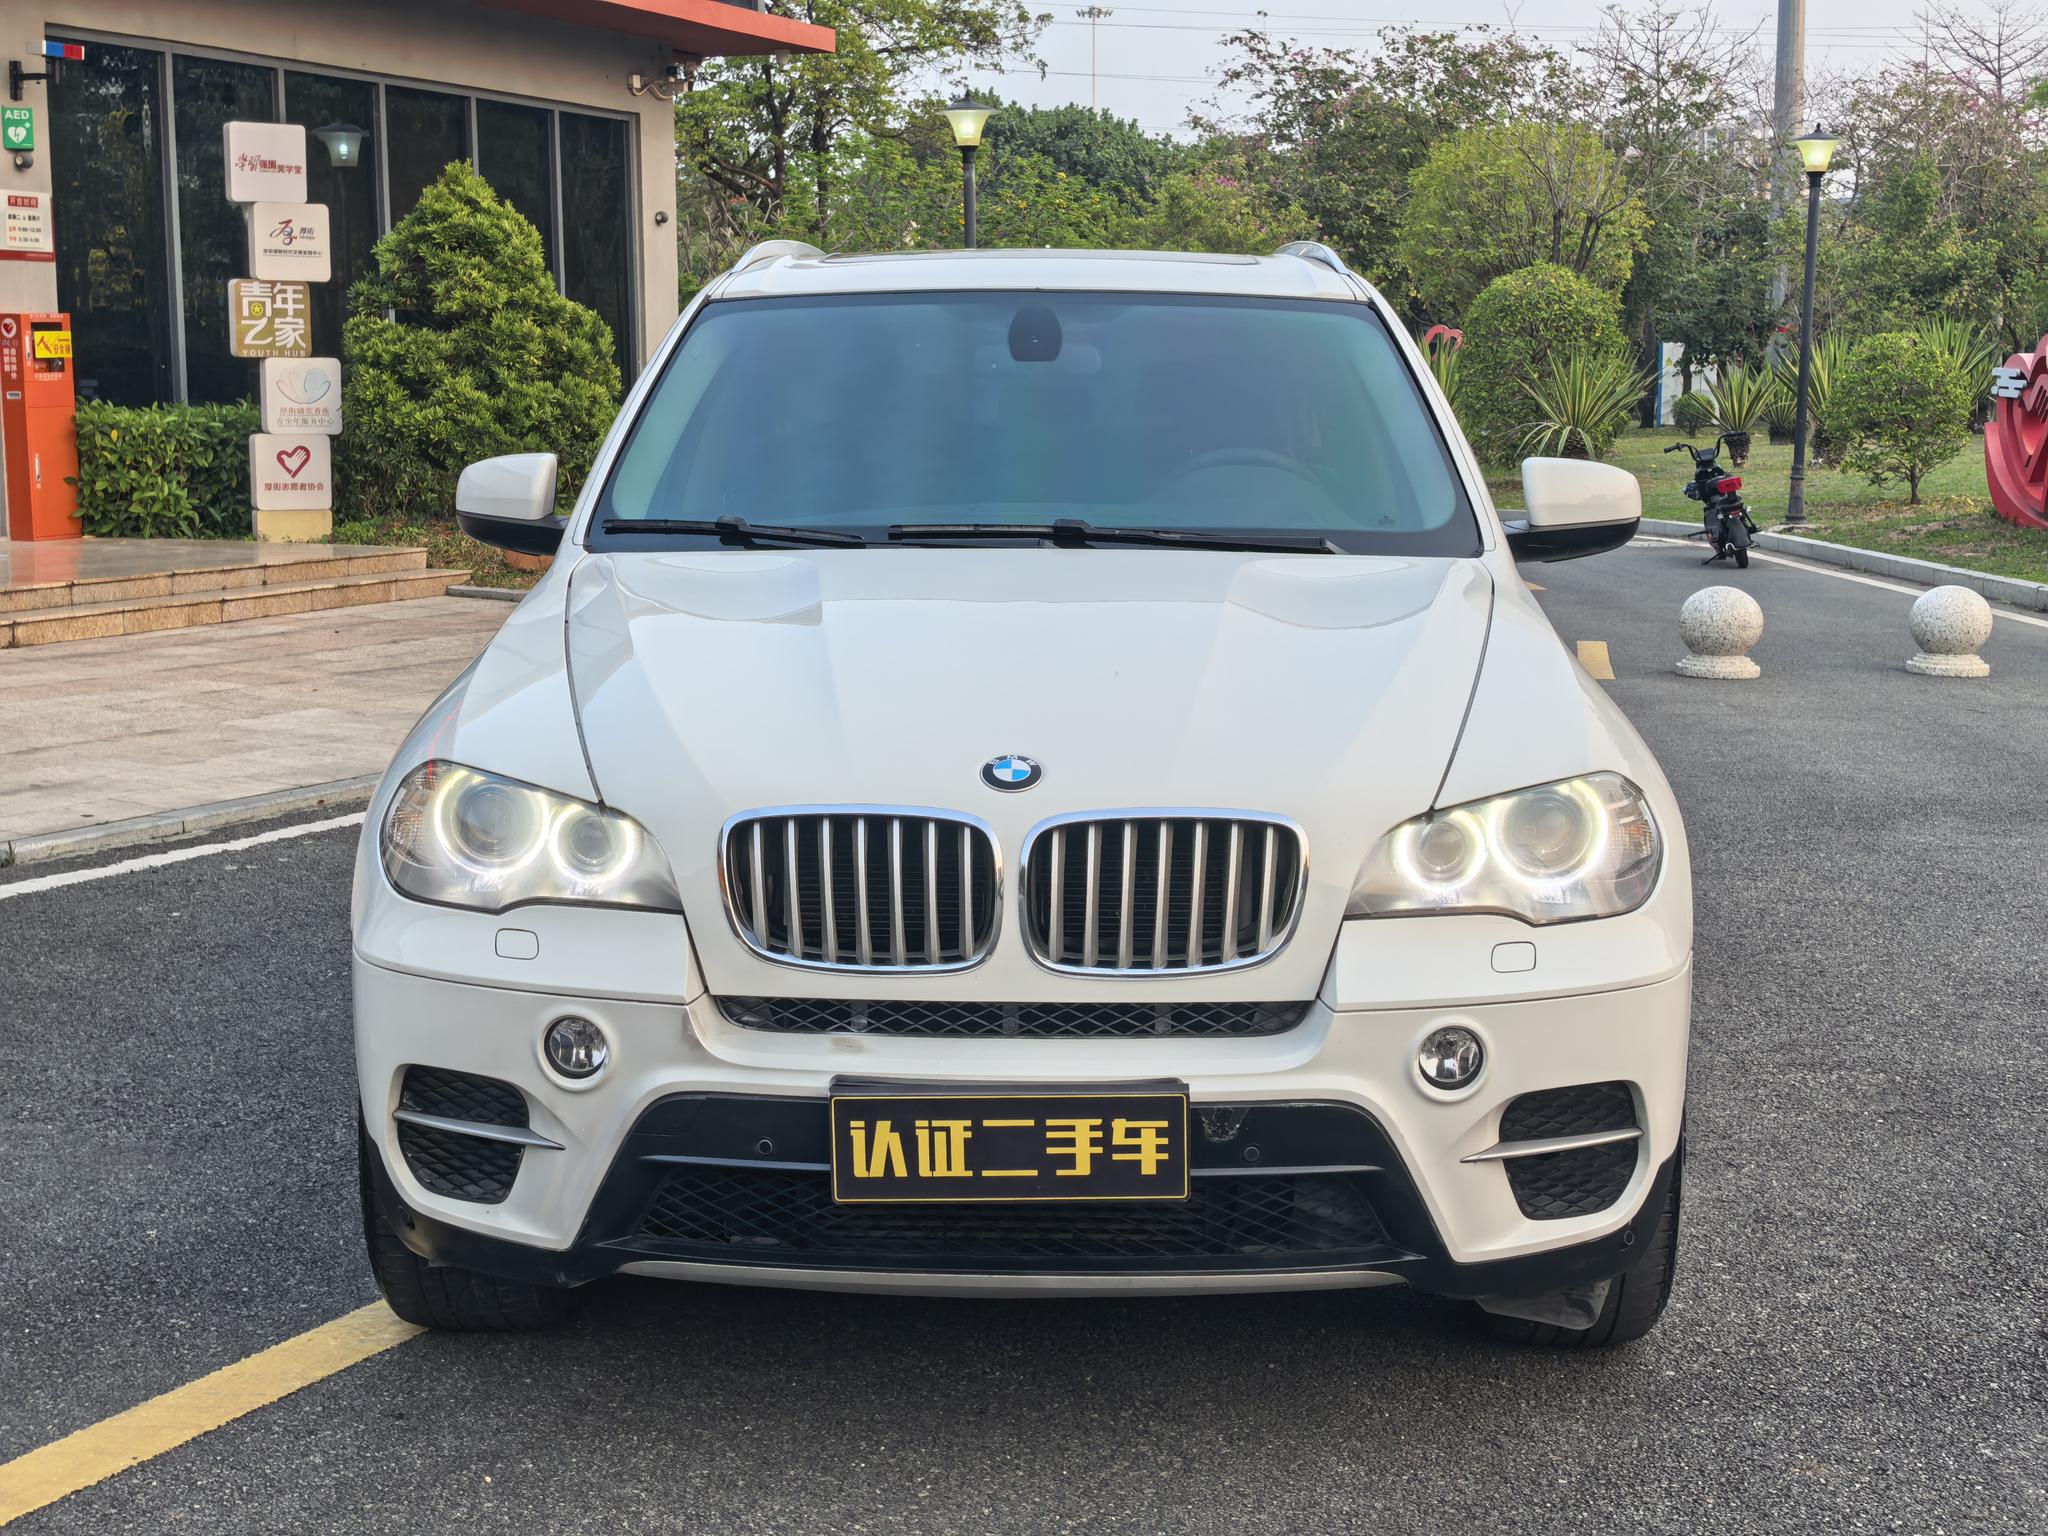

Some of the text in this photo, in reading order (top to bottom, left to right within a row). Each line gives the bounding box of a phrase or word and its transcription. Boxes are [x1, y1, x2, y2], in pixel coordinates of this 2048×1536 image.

[5, 110, 29, 119] AED
[240, 281, 304, 317] 青年
[240, 316, 306, 349] 之家
[243, 349, 306, 358] YOUTH HUB
[264, 482, 324, 491] 厚街志愿者协会
[849, 1118, 1169, 1178] 认证二手车
